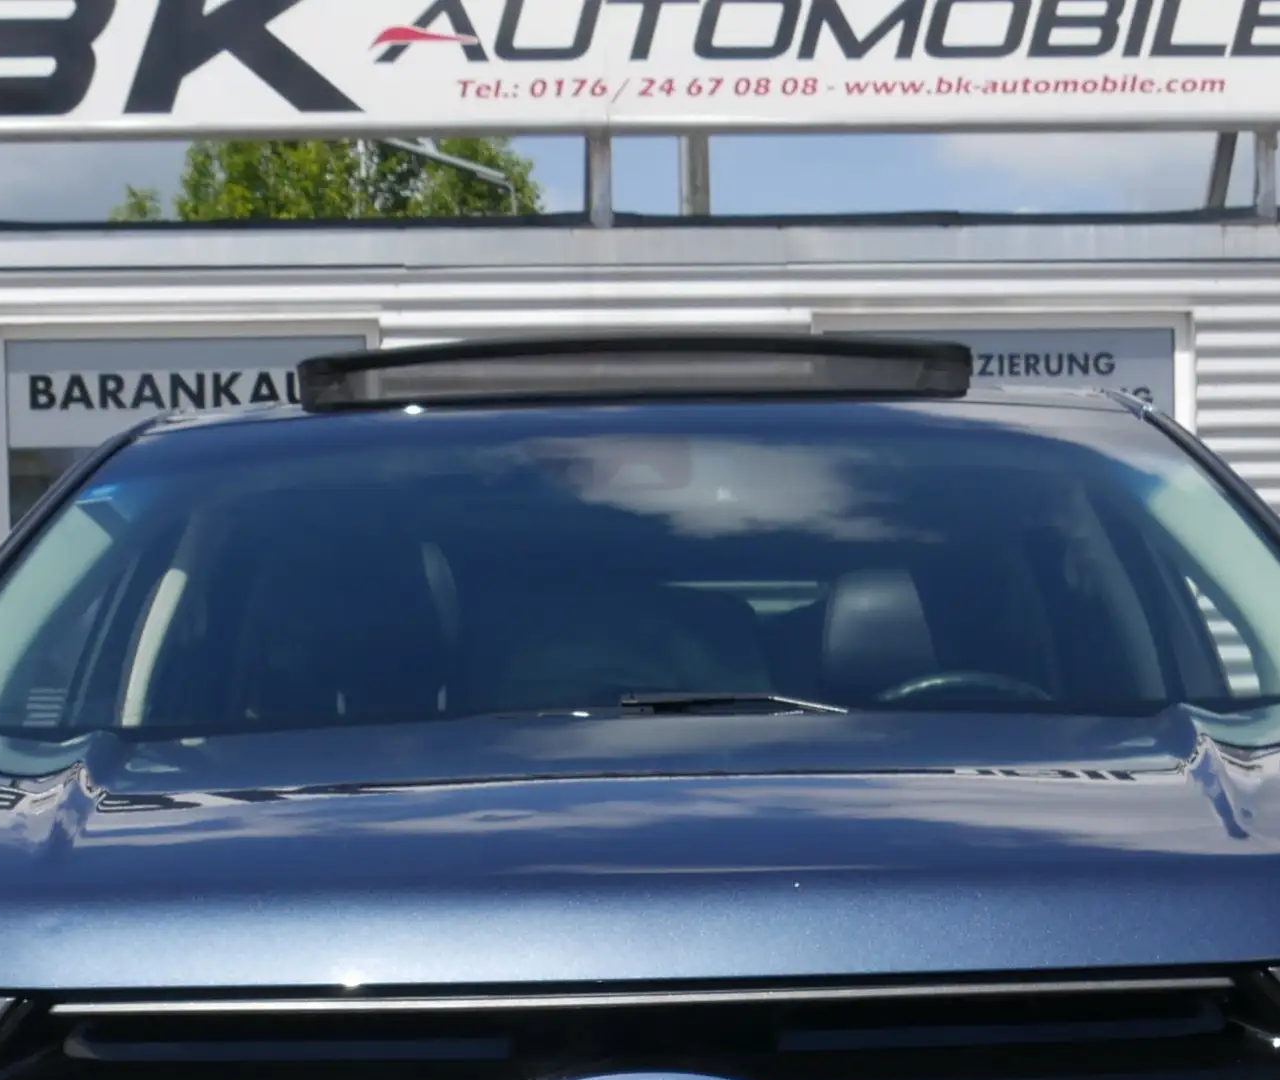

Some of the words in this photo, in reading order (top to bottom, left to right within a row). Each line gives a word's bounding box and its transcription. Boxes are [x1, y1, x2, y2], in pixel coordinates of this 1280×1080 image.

[457, 79, 519, 99] Tel.:
[529, 79, 608, 98] 0176
[637, 78, 676, 97] 24
[686, 77, 723, 97] 67
[733, 77, 771, 96] 08
[781, 77, 818, 96] 08
[844, 74, 1226, 96] www.bk-automobile.com
[970, 352, 1116, 377] ZIERUNG
